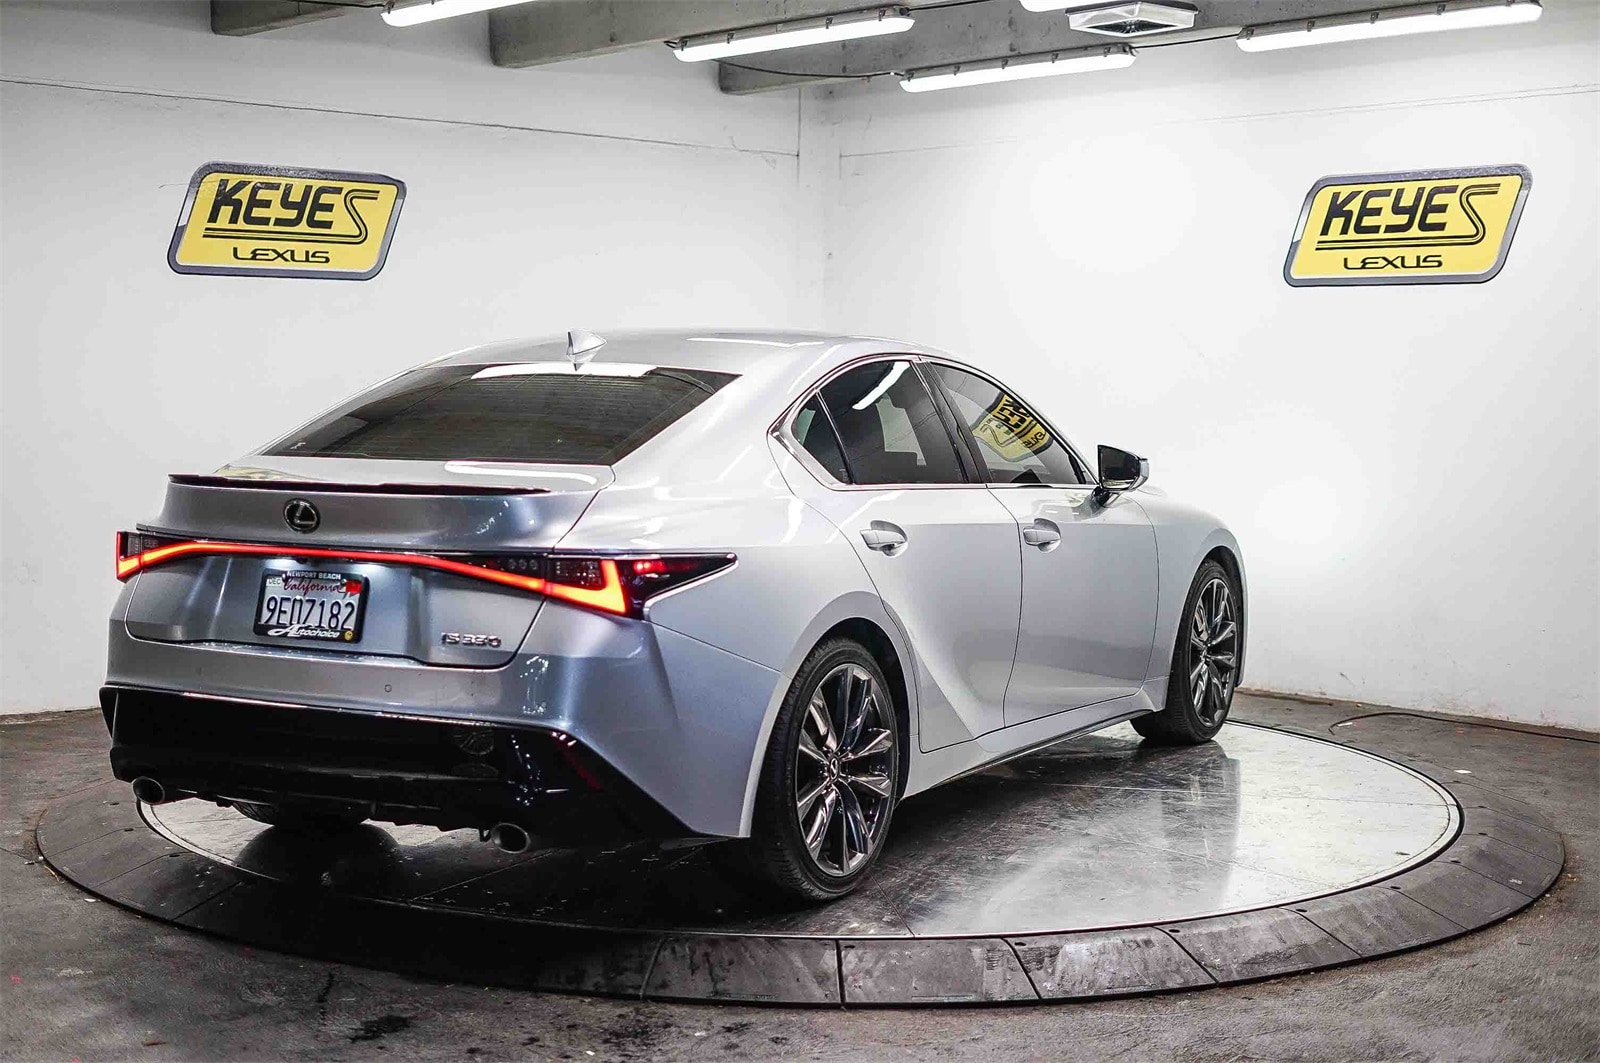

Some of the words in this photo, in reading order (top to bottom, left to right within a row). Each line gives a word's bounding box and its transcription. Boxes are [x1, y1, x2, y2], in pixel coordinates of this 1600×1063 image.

[203, 178, 380, 244] KEYES
[1316, 183, 1501, 250] KEYES
[232, 247, 330, 264] LEXUS
[1343, 254, 1443, 270] LEXUS
[286, 570, 317, 579] NEWPORT
[283, 577, 345, 596] California
[441, 632, 460, 645] IS
